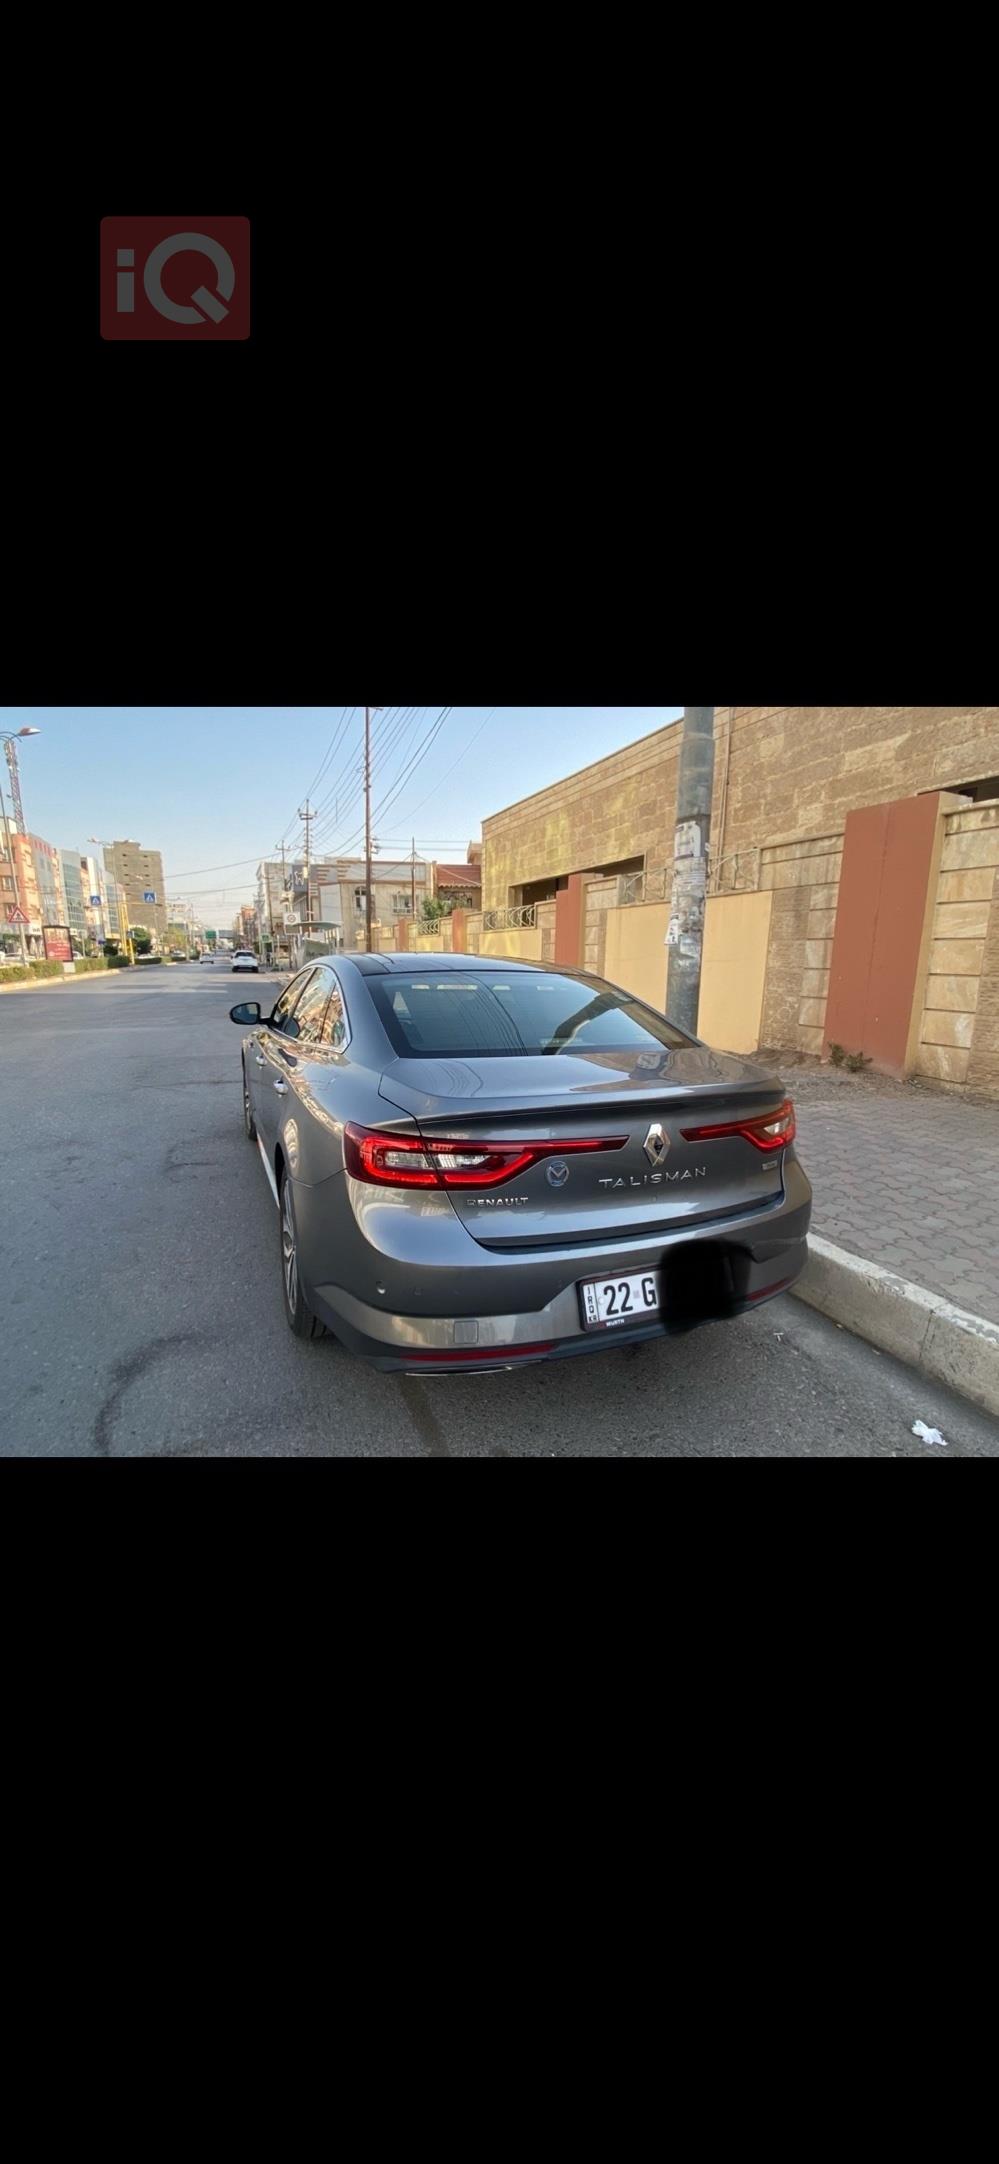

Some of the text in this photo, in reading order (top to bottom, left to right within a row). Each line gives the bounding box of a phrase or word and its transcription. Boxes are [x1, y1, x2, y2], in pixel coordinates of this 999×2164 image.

[599, 1167, 706, 1188] TALISMAN
[467, 1197, 528, 1206] RENAULT
[587, 1286, 595, 1313] IRQ
[603, 1277, 657, 1315] 22 G
